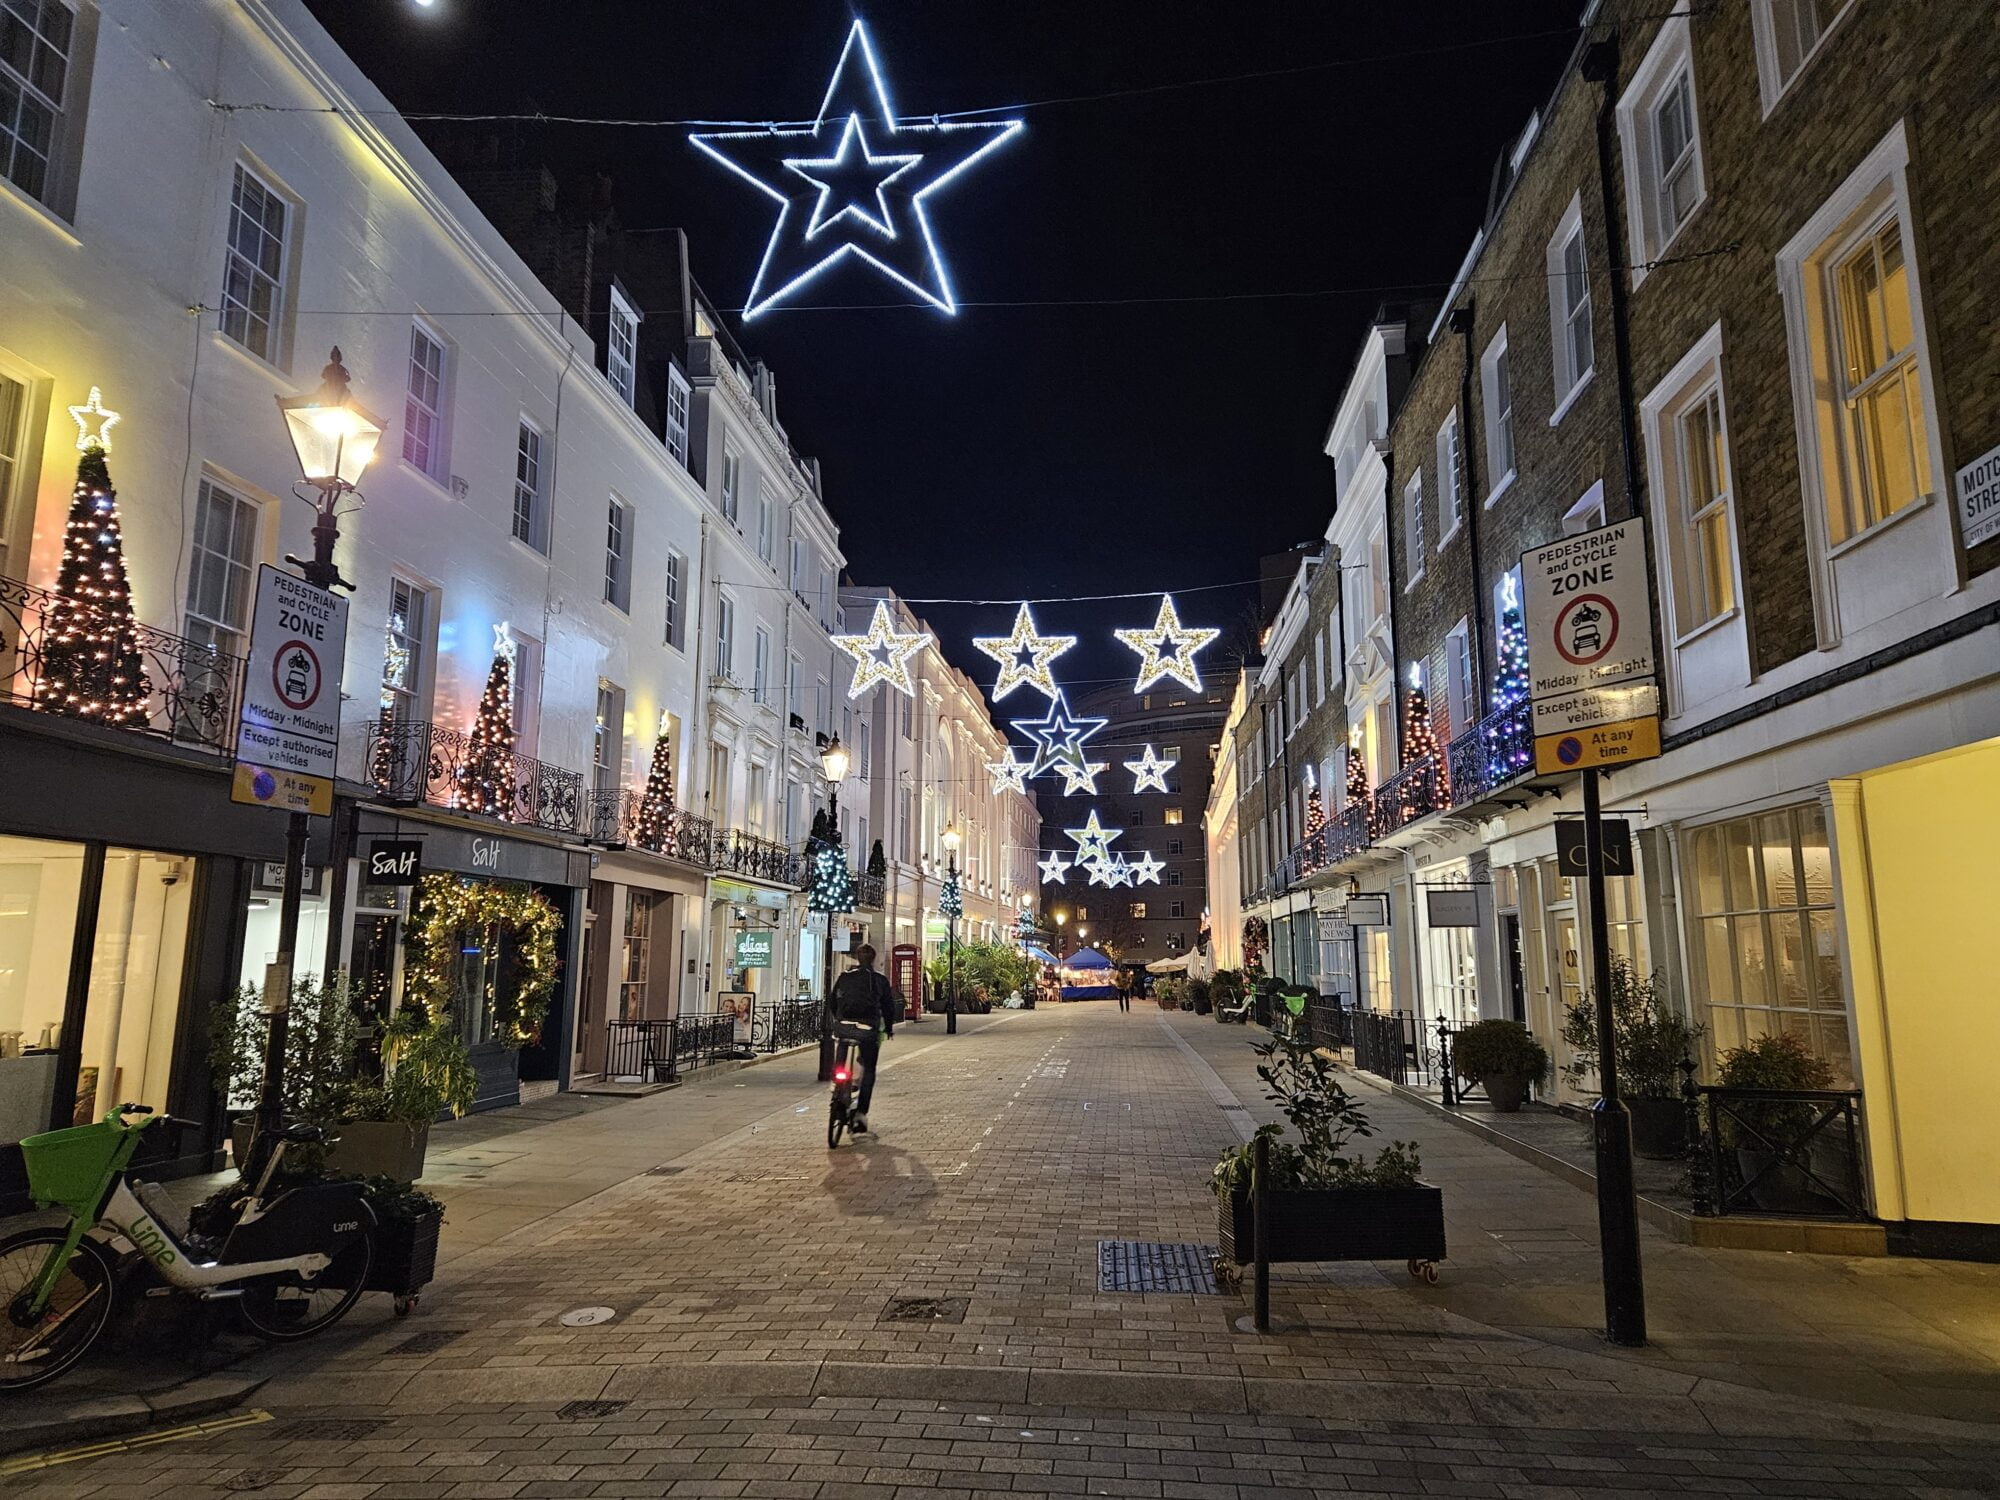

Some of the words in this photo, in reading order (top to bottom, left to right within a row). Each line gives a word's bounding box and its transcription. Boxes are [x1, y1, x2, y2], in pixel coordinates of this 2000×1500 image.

[1966, 481, 2000, 518] STRE
[1538, 528, 1625, 564] PEDESTRIAN
[1547, 561, 1569, 575] and
[1572, 544, 1617, 567] CYCLE
[274, 576, 336, 610] PEDESTRIAN
[1552, 563, 1614, 596] ZONE
[278, 593, 296, 608] and
[298, 601, 330, 621] CYCLE
[278, 609, 324, 641] ZONE
[1536, 674, 1579, 691] Midday
[1589, 657, 1647, 680] Mnight
[249, 703, 285, 725] Midday
[292, 714, 334, 735] Midnight
[1537, 698, 1582, 716] Except
[244, 728, 280, 747] Except
[282, 740, 333, 759] authorised
[1592, 732, 1607, 744] At
[1610, 729, 1634, 741] any
[269, 751, 309, 767] vehicles
[1599, 745, 1628, 758] time
[284, 778, 296, 789] At
[298, 782, 316, 794] any
[287, 794, 310, 806] time
[372, 851, 419, 876] Salt
[472, 838, 500, 869] Salt
[268, 865, 310, 878] MOTB
[1324, 930, 1351, 938] NEWS
